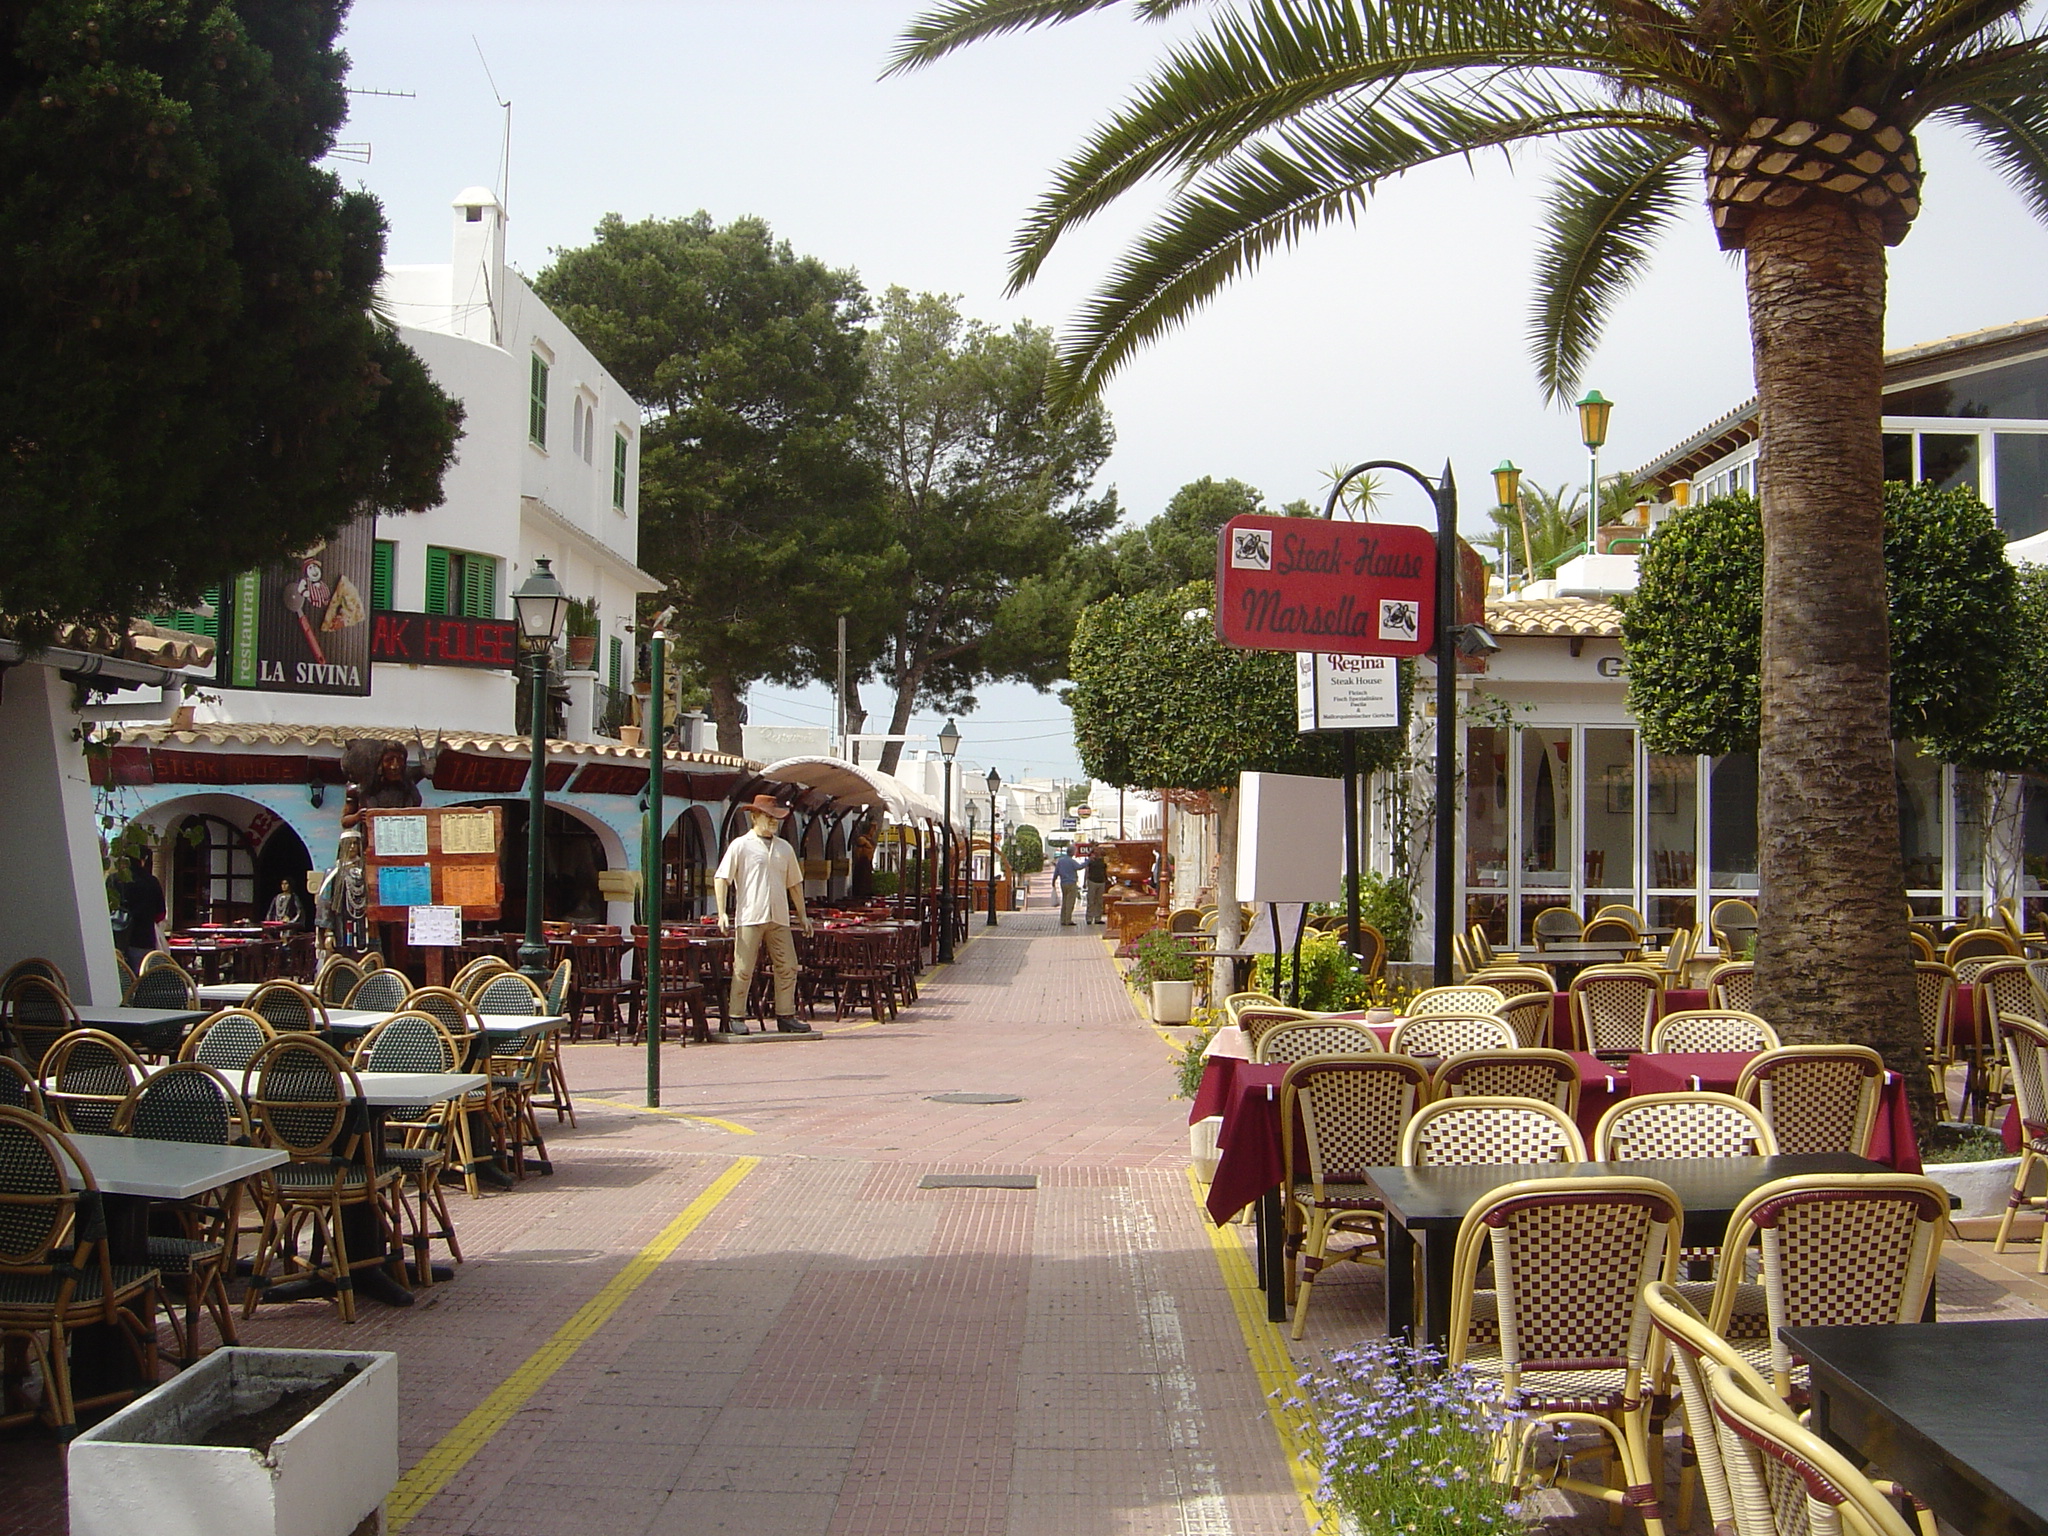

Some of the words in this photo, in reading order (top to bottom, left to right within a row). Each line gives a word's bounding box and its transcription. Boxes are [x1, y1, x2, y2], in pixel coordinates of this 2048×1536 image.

[1242, 588, 1370, 637] Marsella
[371, 615, 410, 657] AK
[424, 619, 516, 664] HOUSE
[260, 660, 286, 682] LA
[296, 662, 361, 687] SIVINA
[1327, 653, 1385, 673] Regina
[1597, 656, 1624, 677] G
[1331, 677, 1354, 686] Steak
[1356, 676, 1383, 685] House
[155, 757, 219, 778] STEAK
[450, 760, 524, 787] TASTE
